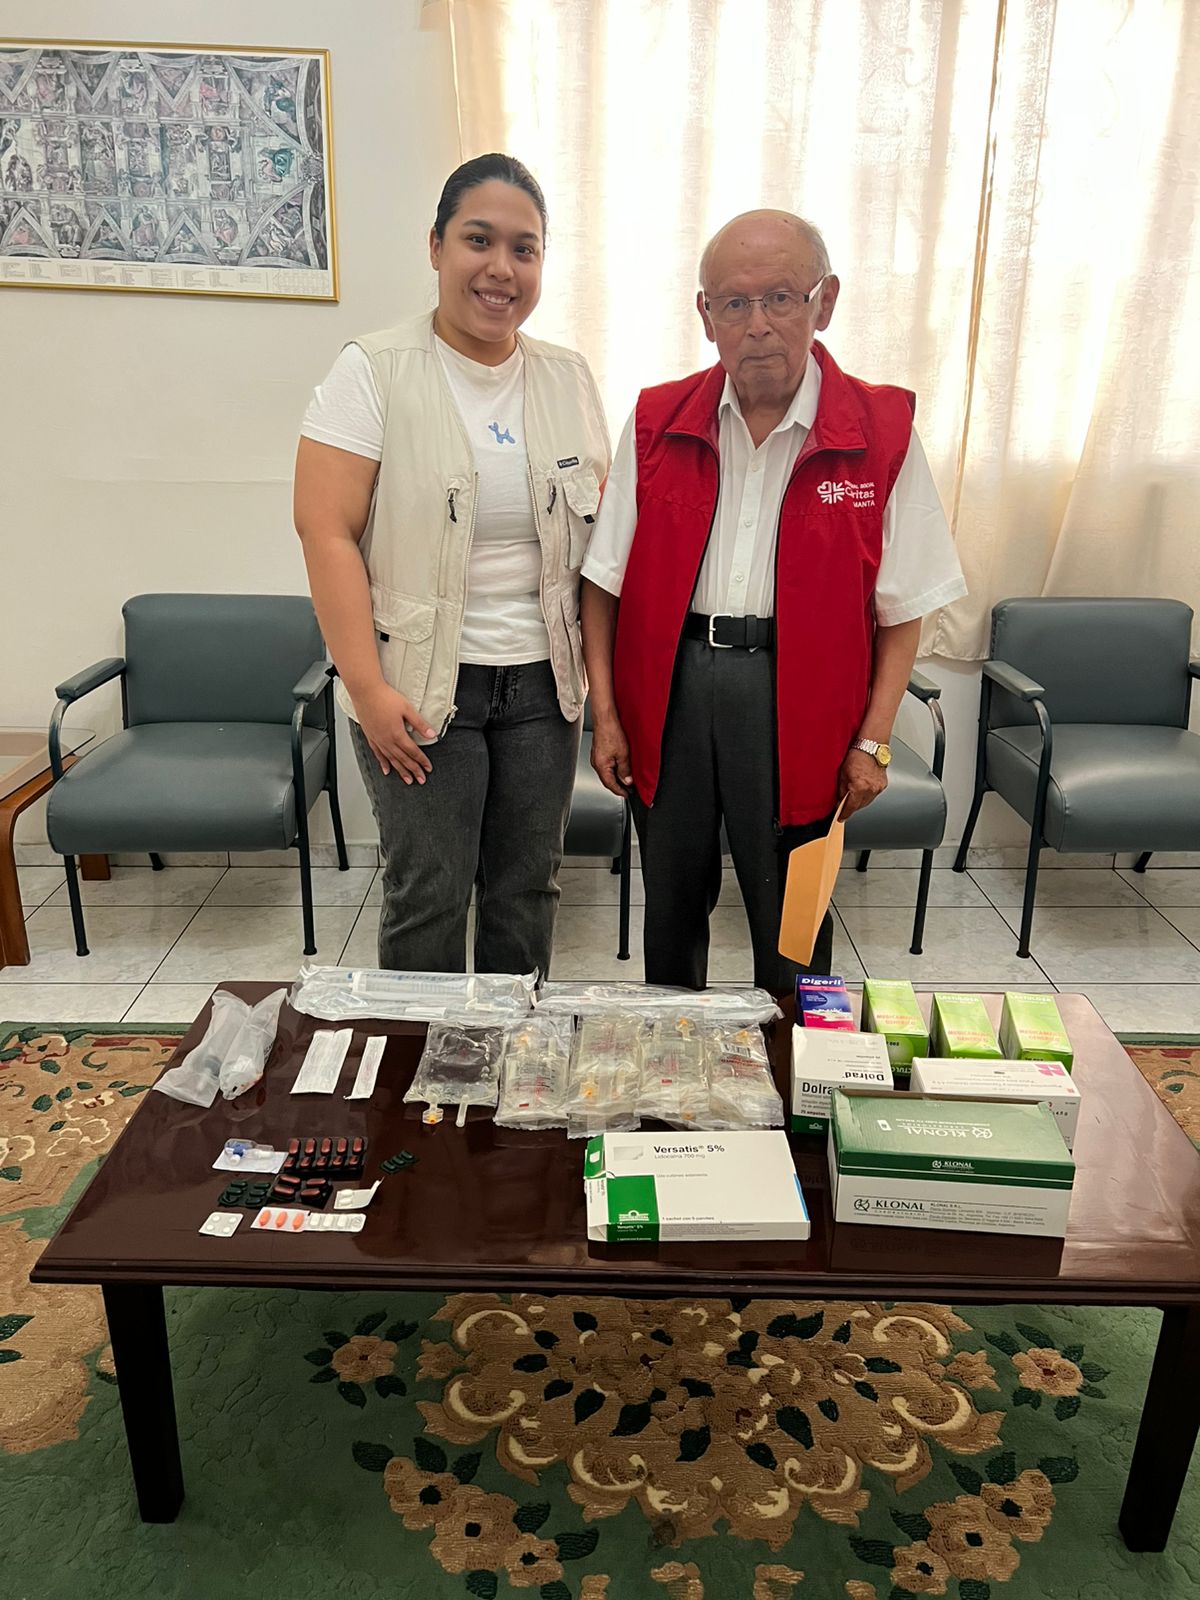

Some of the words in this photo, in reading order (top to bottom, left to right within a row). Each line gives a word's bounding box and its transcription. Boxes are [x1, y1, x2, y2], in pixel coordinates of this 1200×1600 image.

[801, 977, 841, 986] Digeril
[906, 1127, 969, 1137] KLONAL
[706, 1144, 726, 1153] 5%
[875, 1199, 926, 1211] KLONAL
